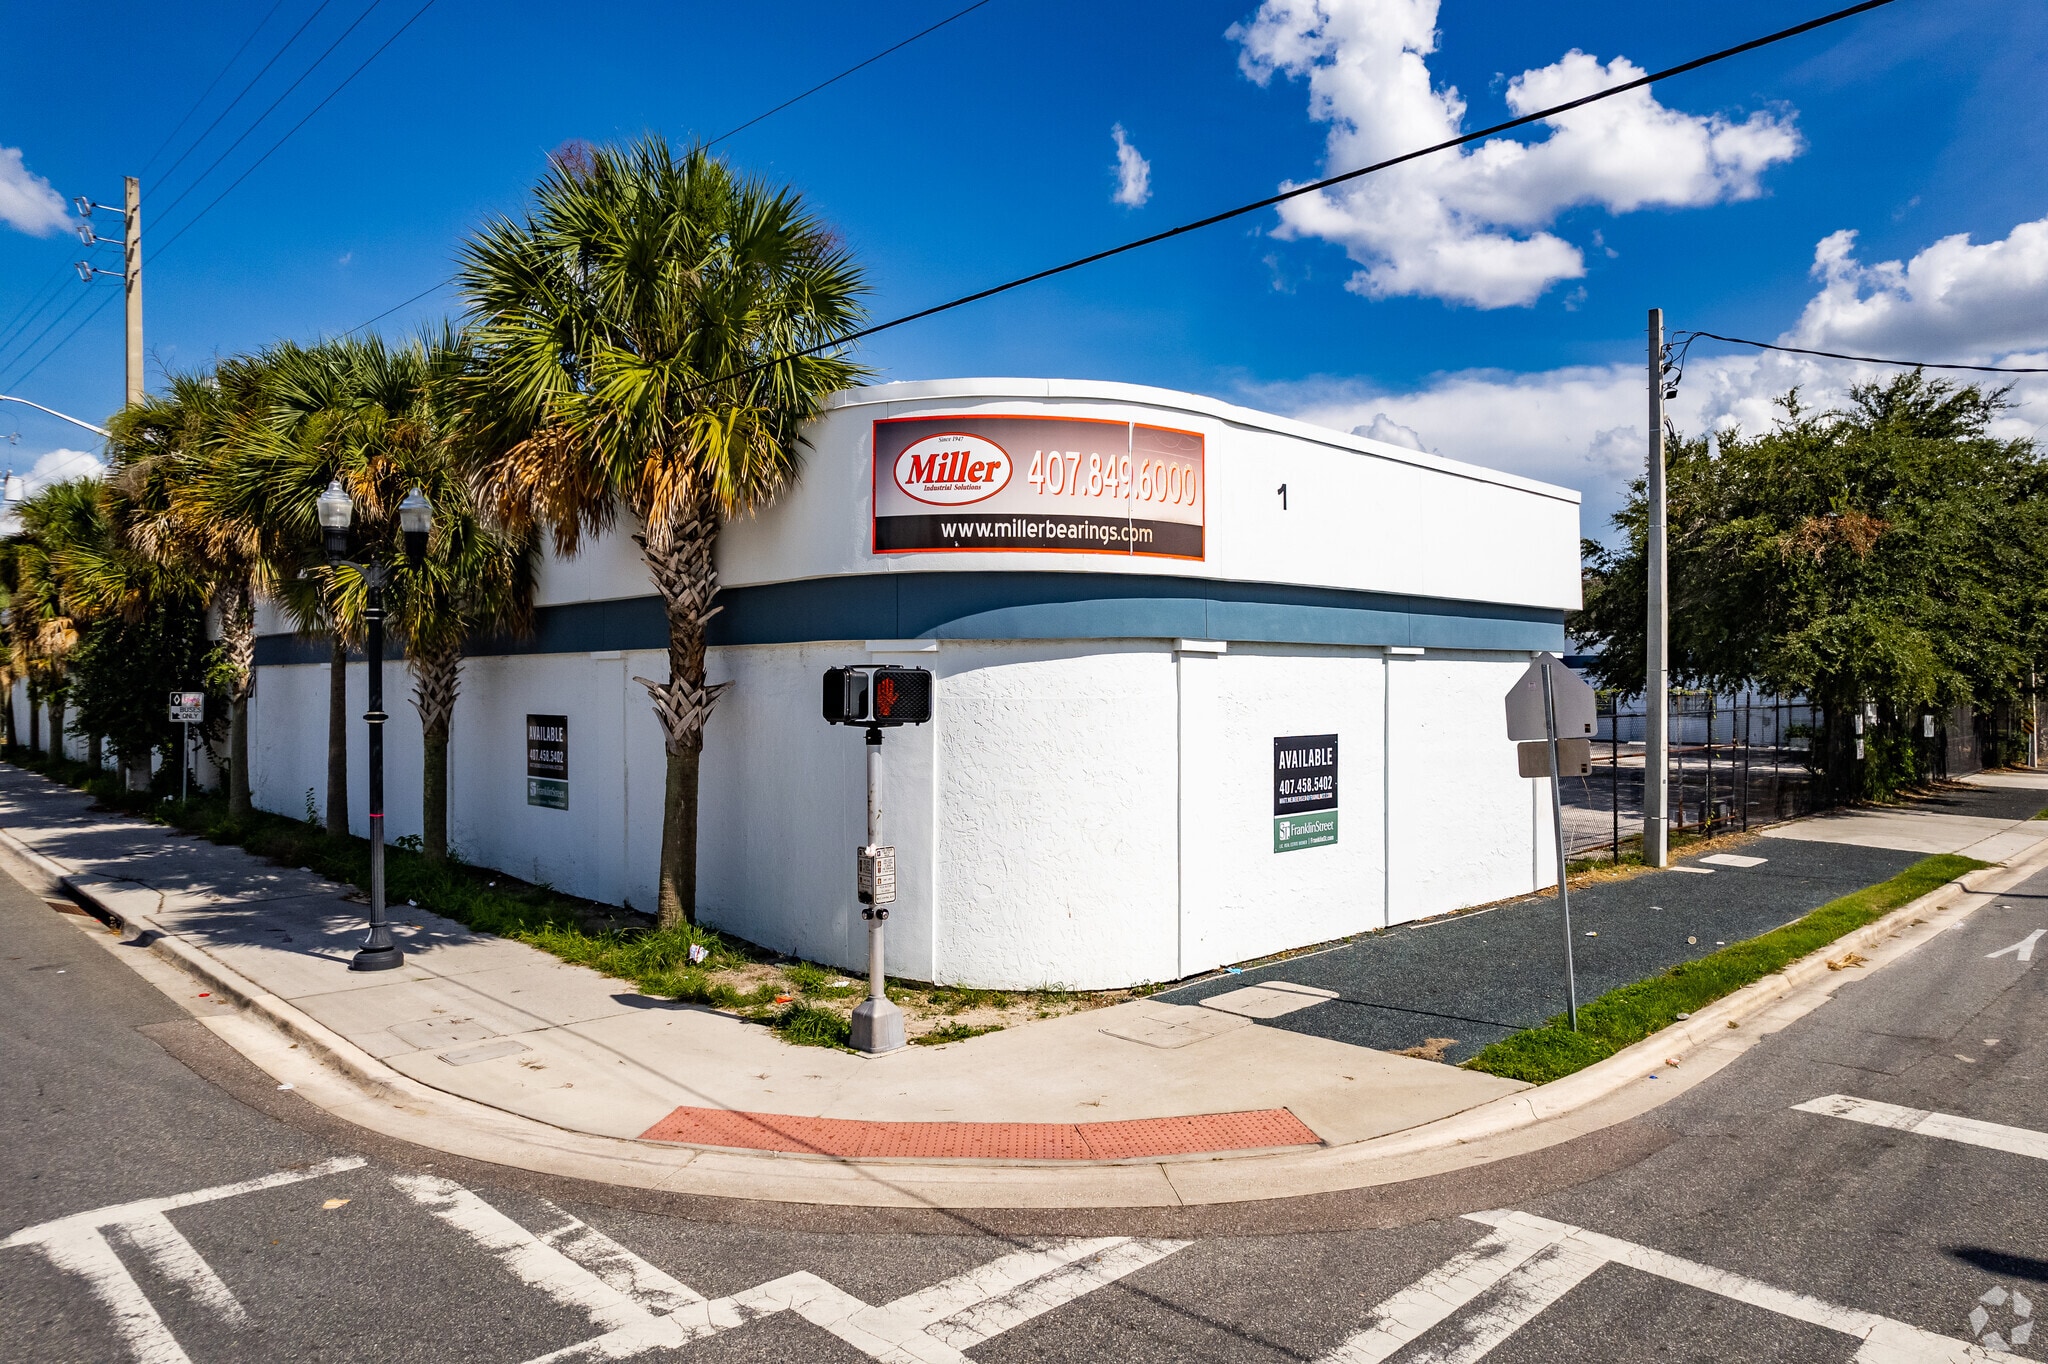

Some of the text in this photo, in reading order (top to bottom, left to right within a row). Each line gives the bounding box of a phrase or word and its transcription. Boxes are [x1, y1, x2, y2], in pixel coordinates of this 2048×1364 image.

[905, 451, 1001, 484] Miller
[1027, 450, 1197, 506] 407.849.6000
[1277, 483, 1287, 511] 1
[941, 518, 1153, 546] www.millerbearings.com
[529, 726, 564, 742] AVAILABLE
[529, 749, 564, 763] 407.458.5402
[1279, 747, 1333, 770] AVAILABLE
[1279, 775, 1333, 795] 407.458.5402
[1290, 820, 1334, 837] FranklinStreet
